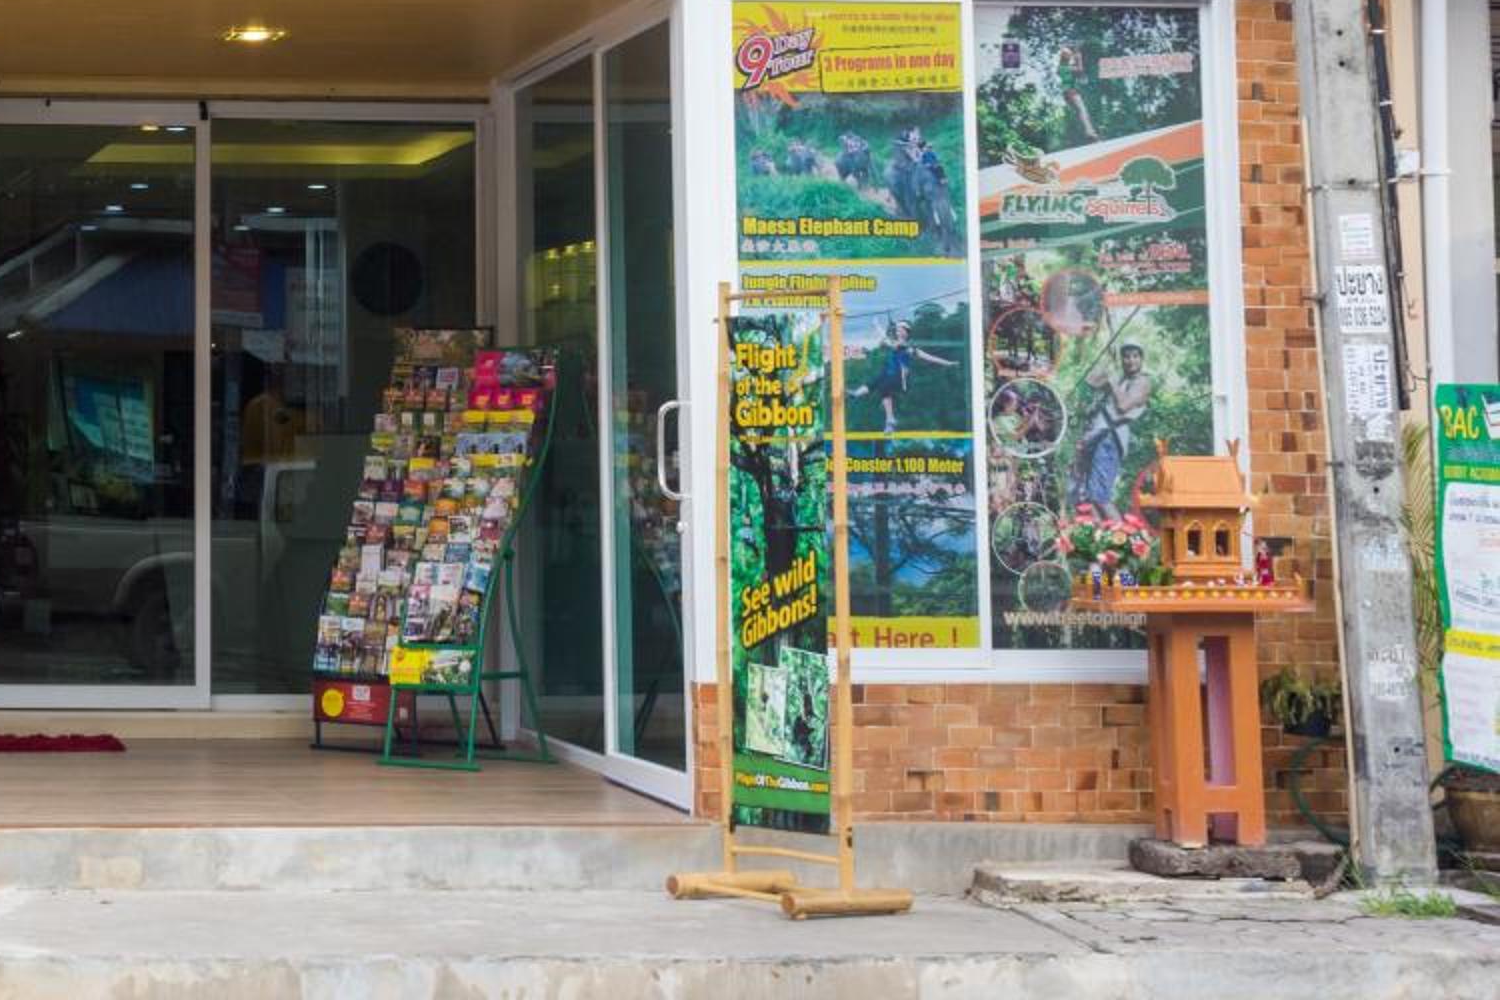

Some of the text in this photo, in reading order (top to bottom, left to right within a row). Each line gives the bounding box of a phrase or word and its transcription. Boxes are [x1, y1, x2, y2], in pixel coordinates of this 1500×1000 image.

[799, 217, 870, 238] Elephant
[872, 218, 920, 239] Camp
[735, 342, 797, 374] Flight
[736, 375, 782, 396] of the
[735, 398, 814, 428] Gibbon
[741, 549, 816, 618] See wild
[742, 582, 818, 649] Gibbons!
[874, 627, 935, 648] Here
